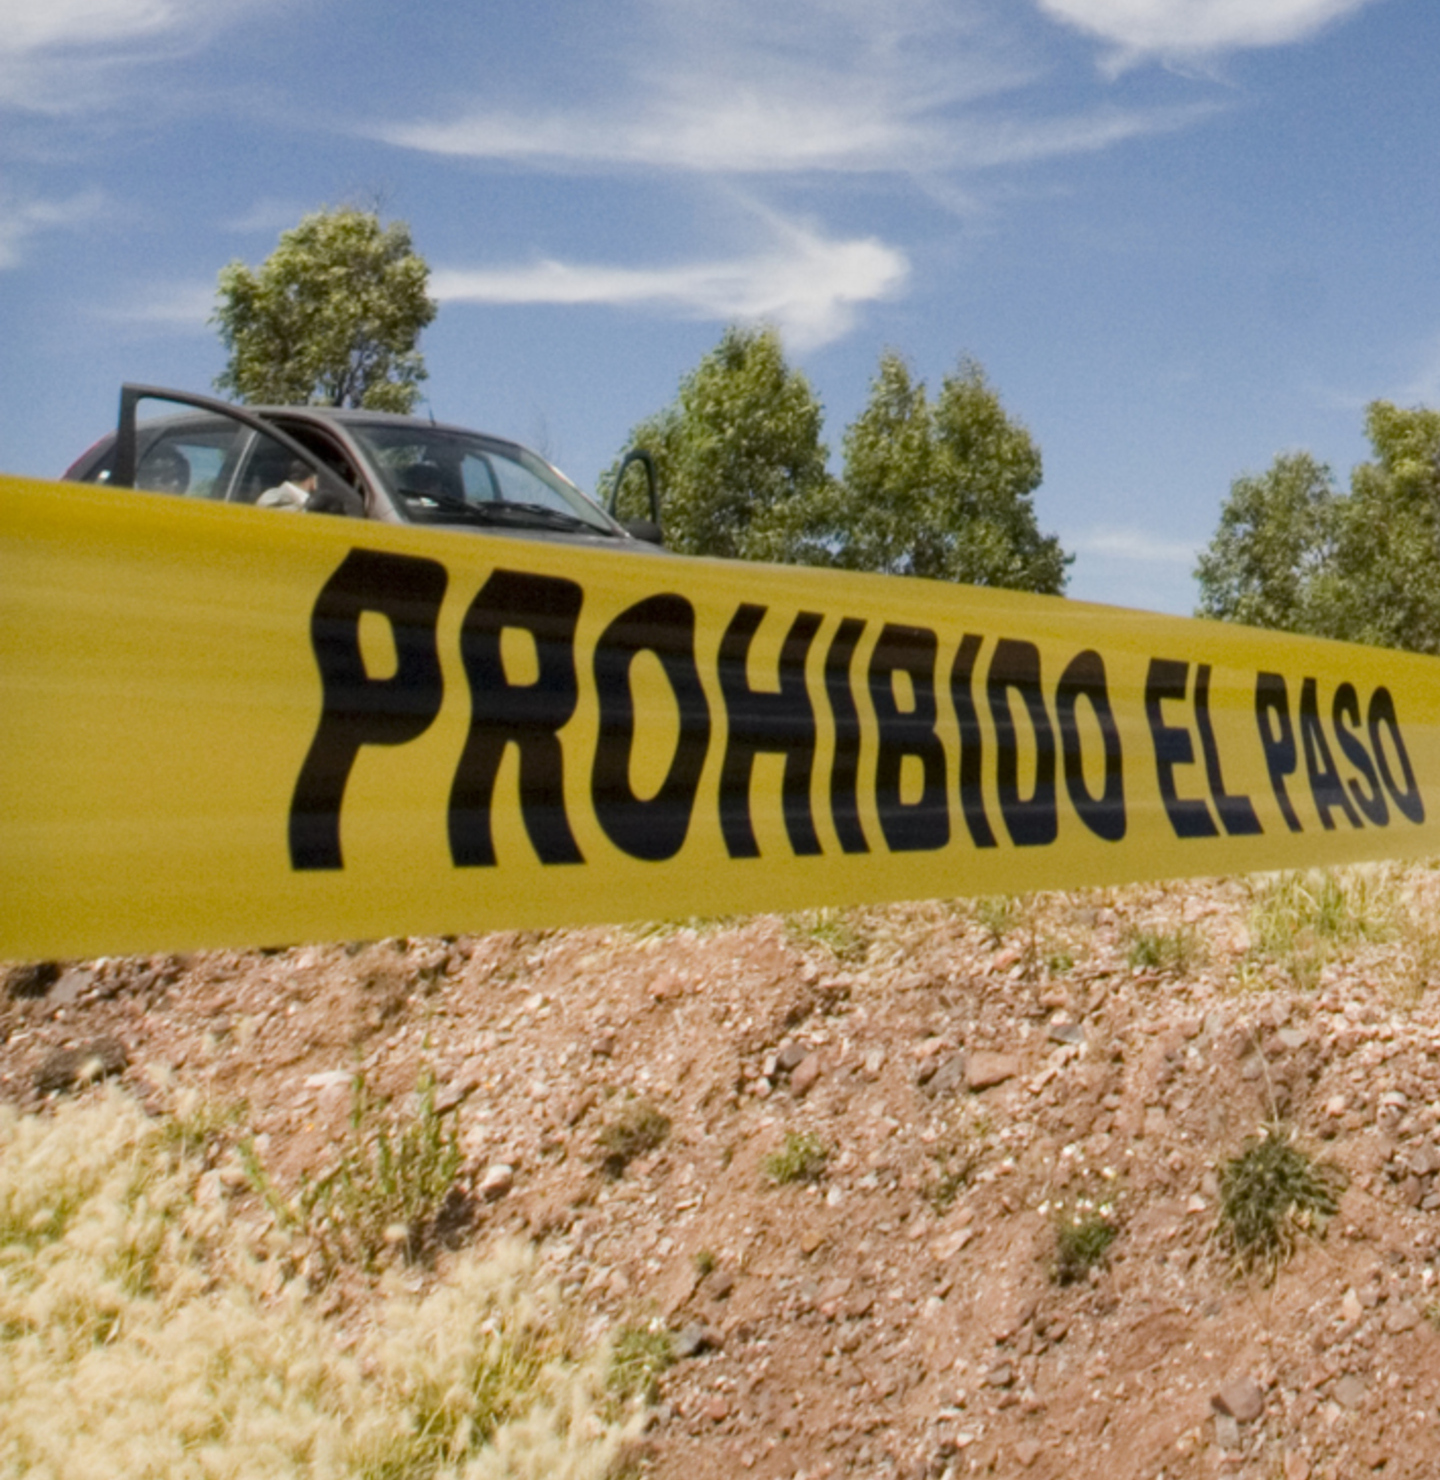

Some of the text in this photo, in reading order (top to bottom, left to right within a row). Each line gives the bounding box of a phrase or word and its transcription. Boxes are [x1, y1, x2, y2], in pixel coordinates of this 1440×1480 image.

[288, 547, 1426, 872] PROHIBIDO EL PASO
